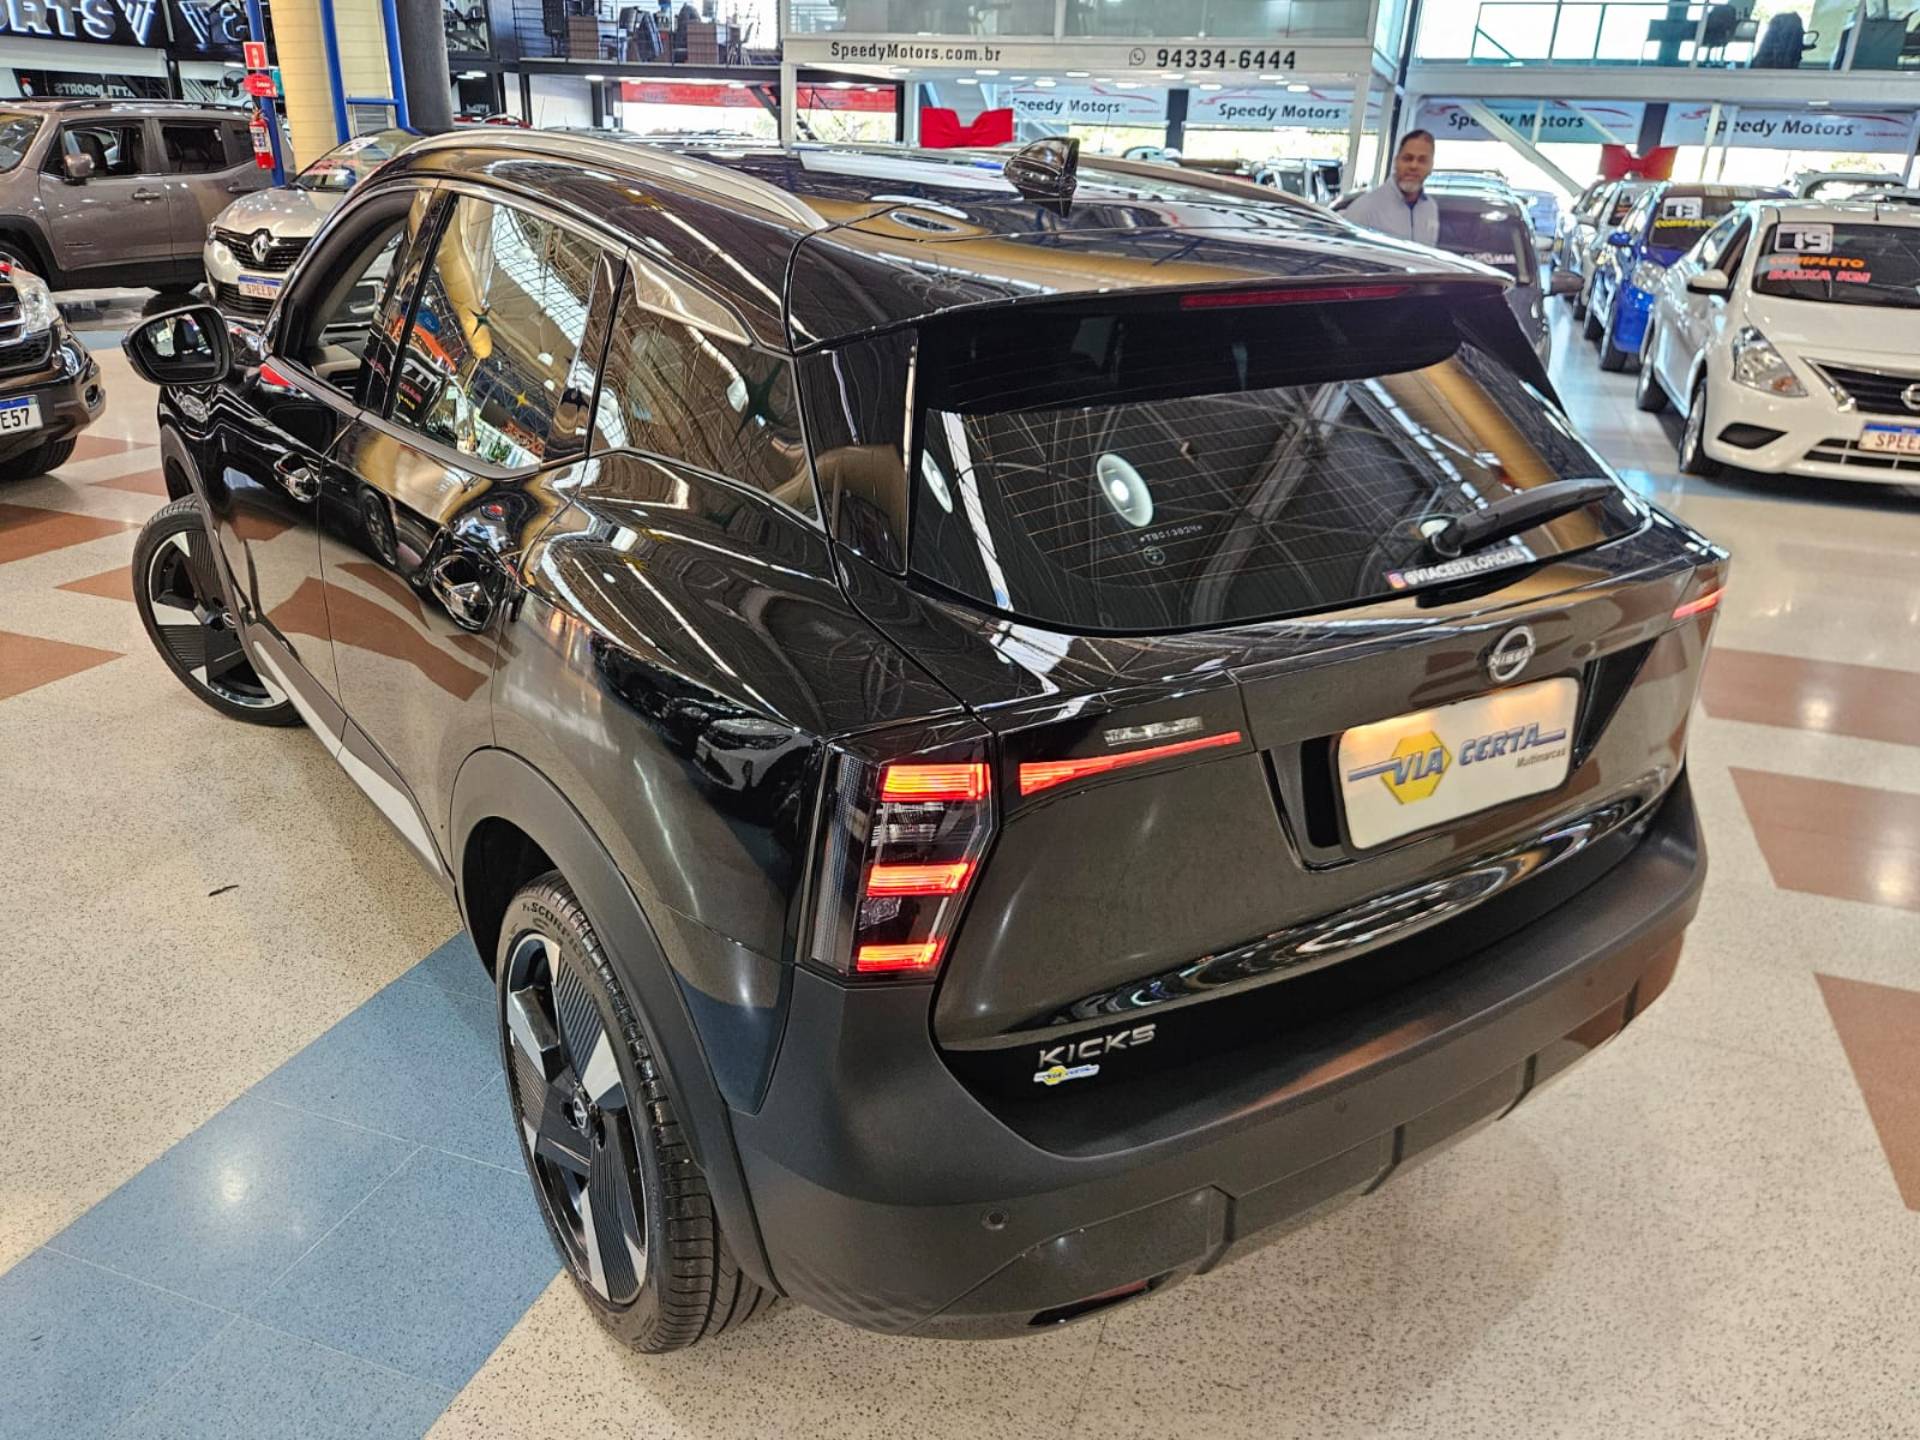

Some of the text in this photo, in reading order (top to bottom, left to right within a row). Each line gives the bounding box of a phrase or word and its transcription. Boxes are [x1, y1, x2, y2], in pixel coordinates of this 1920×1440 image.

[0, 0, 116, 39] RTS
[831, 42, 1000, 61] SpeedyMotors.com.br
[1157, 49, 1296, 69] 94334-6444
[1068, 99, 1120, 113] Motors
[1218, 103, 1340, 120] Speedy Motors
[1781, 120, 1854, 135] Motors
[1769, 256, 1865, 268] COMPLETO
[1388, 722, 1541, 786] VIA CERTA
[1038, 1023, 1156, 1068] KICKS
